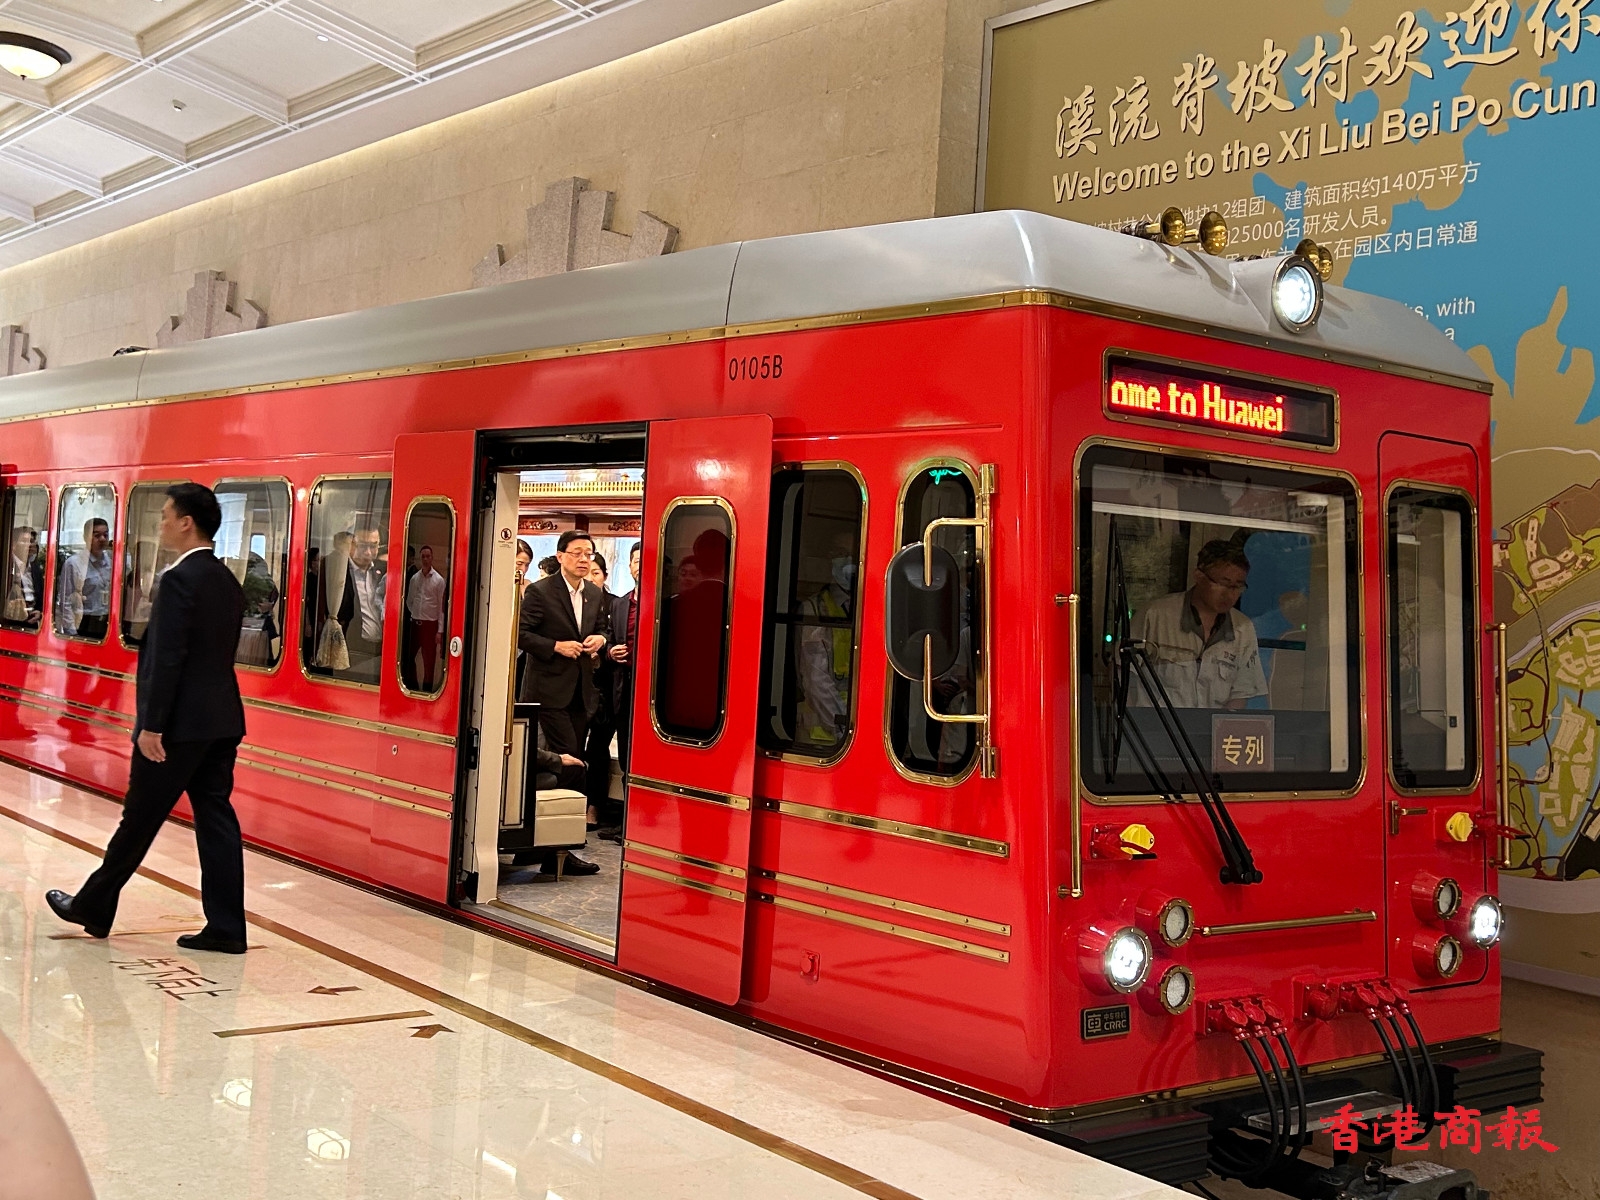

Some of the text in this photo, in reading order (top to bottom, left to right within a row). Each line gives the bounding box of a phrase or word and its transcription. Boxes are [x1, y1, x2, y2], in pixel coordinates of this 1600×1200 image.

[1055, 0, 1600, 159] 溪流背坡村欢迎你
[1052, 77, 1597, 203] Welcome to the Xi Liu Bei Po Cun
[1225, 206, 1388, 247] 25000名研发人员。
[1436, 296, 1476, 317] with
[1444, 326, 1456, 341] a
[728, 354, 784, 381] 0105B
[1111, 380, 1284, 433] ome to Huawei
[1221, 734, 1265, 766] 专列
[109, 957, 233, 1001] 先下后上
[1103, 1019, 1127, 1031] CRRC
